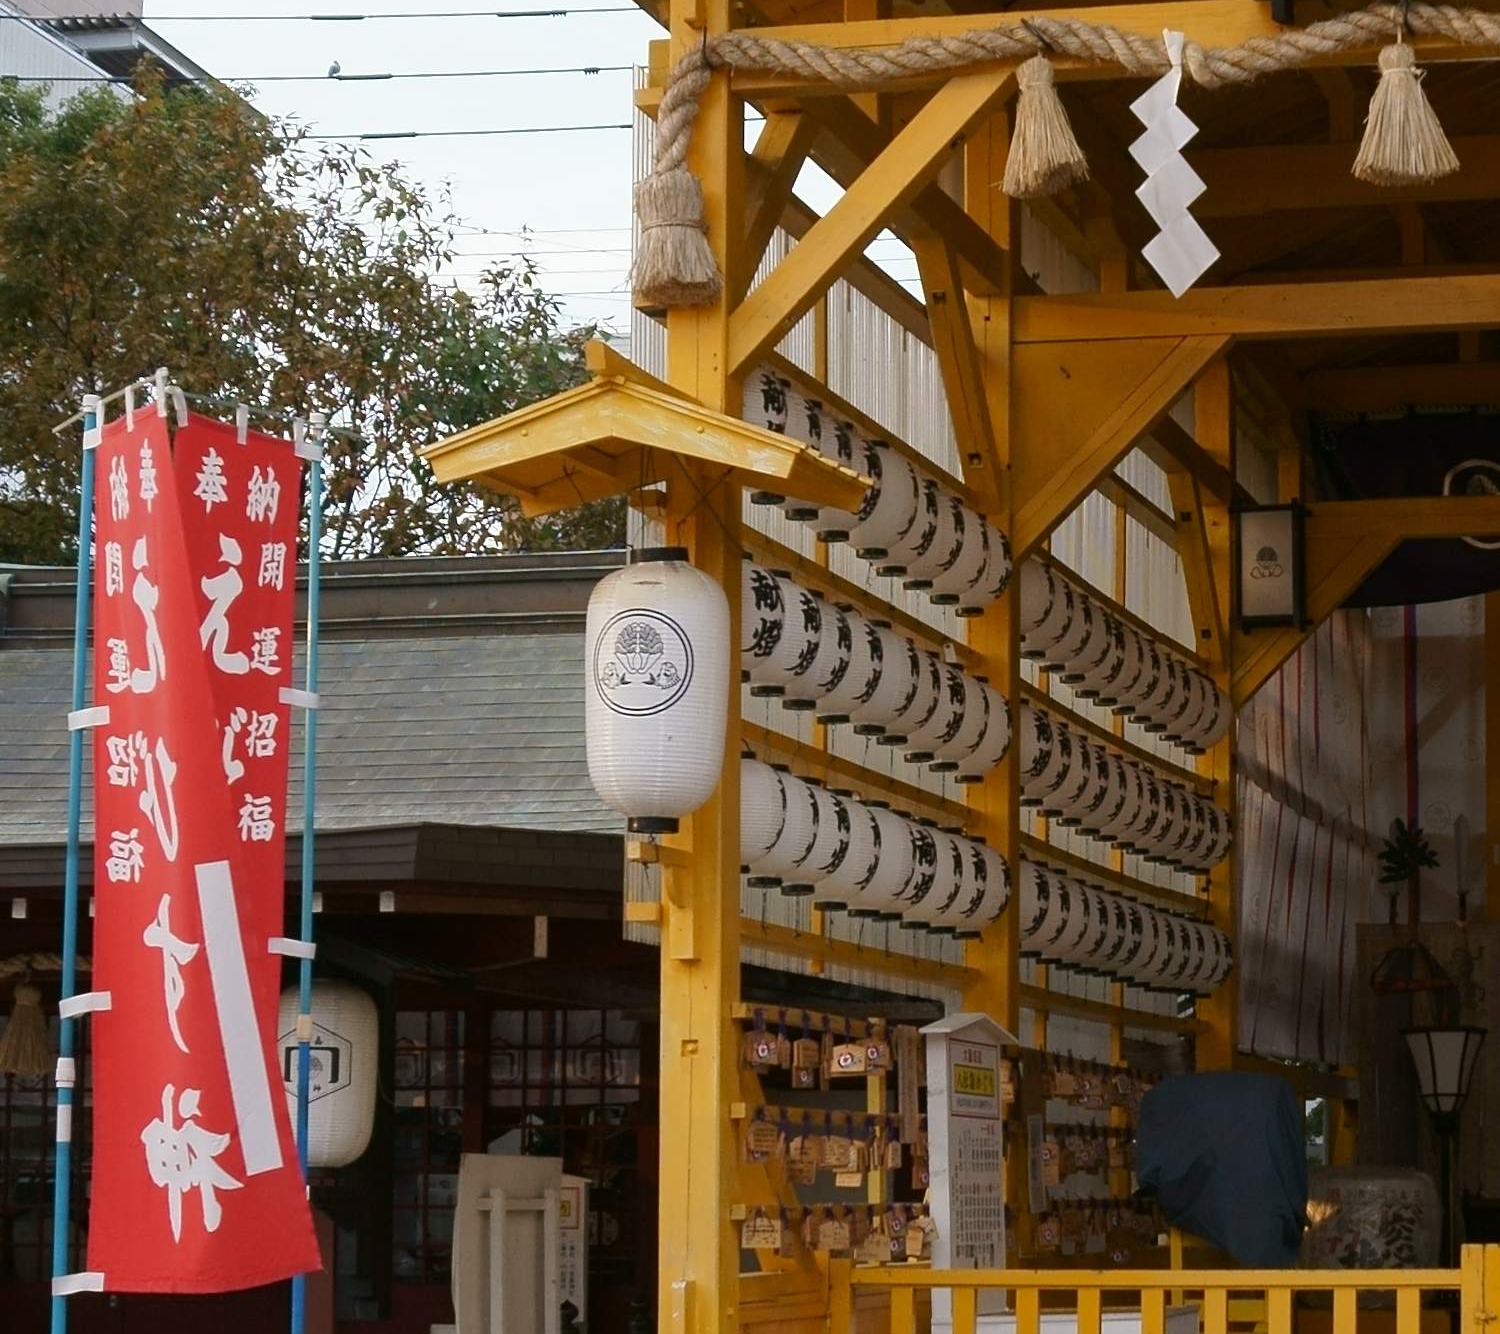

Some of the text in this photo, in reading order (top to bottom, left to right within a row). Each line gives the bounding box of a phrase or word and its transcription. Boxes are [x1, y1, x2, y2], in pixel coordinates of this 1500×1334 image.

[193, 447, 281, 526] 奉納
[237, 540, 289, 843] 開運招福
